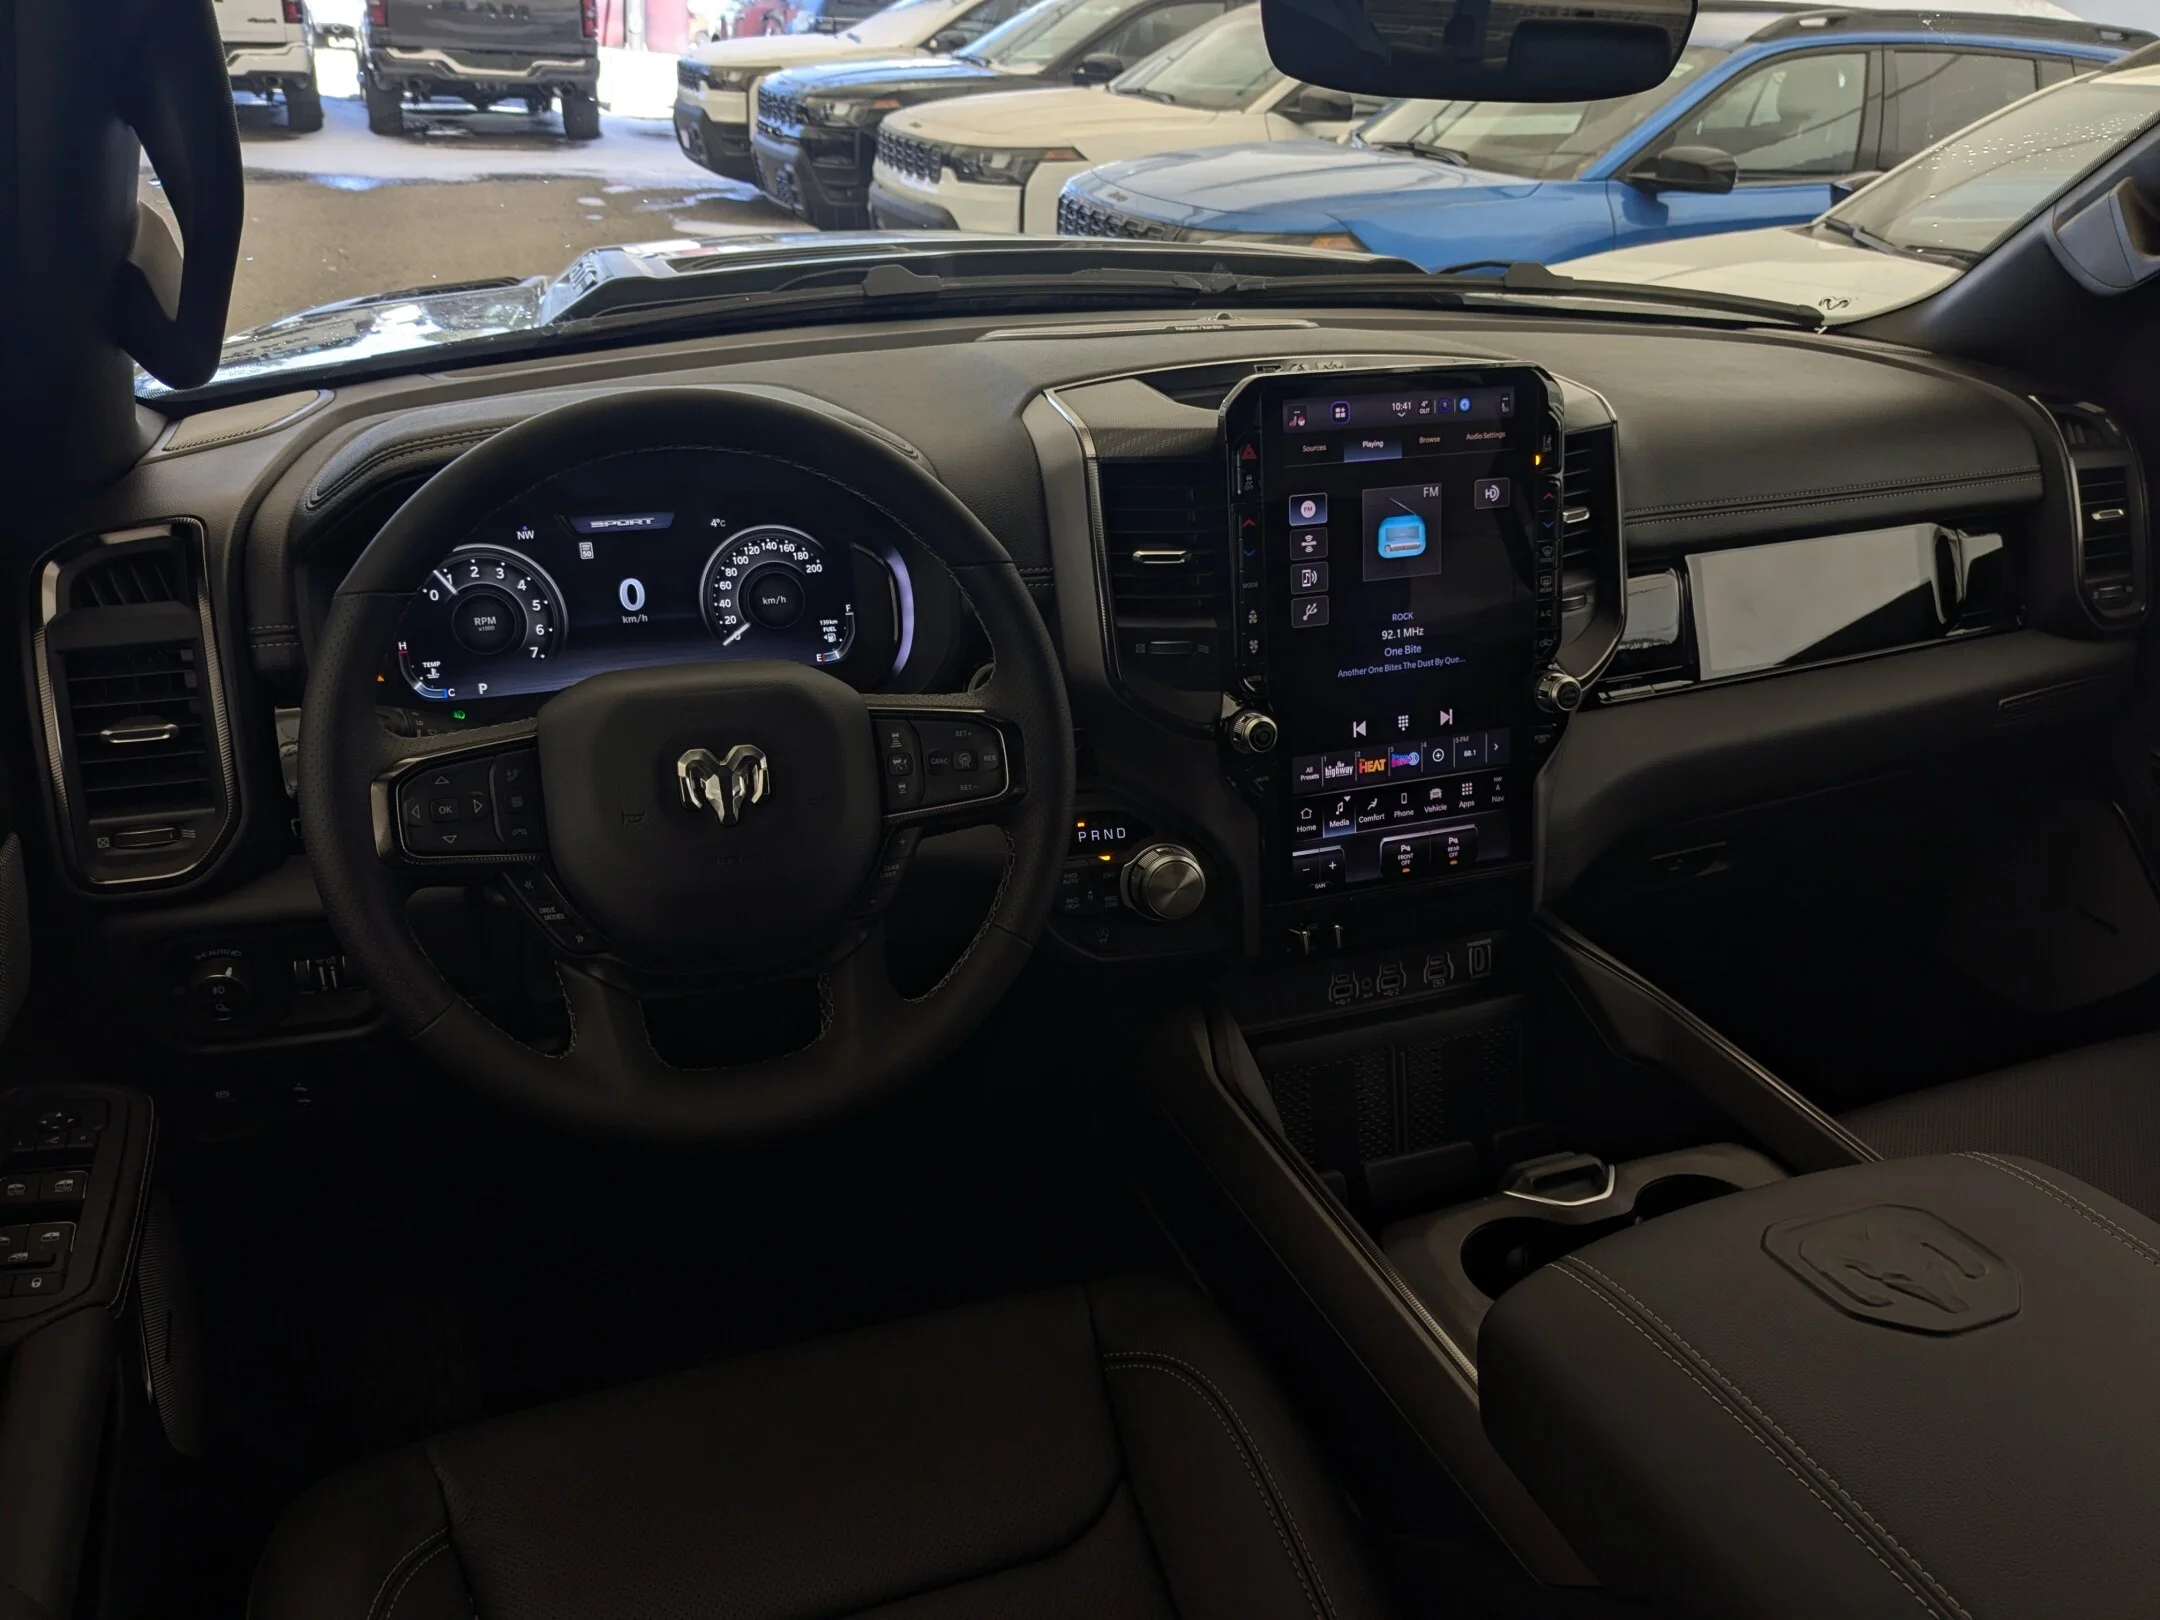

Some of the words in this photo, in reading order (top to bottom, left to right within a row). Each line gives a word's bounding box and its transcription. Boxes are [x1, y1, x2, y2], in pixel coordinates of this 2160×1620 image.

[1392, 401, 1412, 411] 10:41
[1419, 435, 1441, 444] Browse
[1466, 432, 1484, 441] Audio
[1485, 430, 1506, 441] Settings
[1302, 443, 1327, 453] Sources
[1362, 440, 1383, 450] Playing
[1423, 486, 1438, 497] FM
[591, 517, 655, 528] SPORT
[517, 530, 534, 540] NW
[744, 546, 760, 555] 120
[761, 542, 777, 551] 140
[779, 543, 795, 552] 160
[732, 556, 749, 565] 100
[793, 551, 809, 561] 180
[470, 566, 480, 578] 2
[496, 568, 505, 579] 3
[725, 568, 737, 577] 80
[806, 564, 822, 574] 200
[517, 580, 527, 591] 4
[719, 581, 732, 590] 60
[1242, 581, 1259, 589] MODE
[429, 590, 439, 601] 0
[618, 577, 645, 612] 0
[532, 600, 541, 611] 5
[719, 599, 731, 608] 40
[762, 596, 786, 605] km/h
[846, 604, 851, 612] F
[474, 616, 497, 626] RPM
[622, 614, 648, 624] km/h
[724, 615, 736, 625] 20
[1392, 612, 1414, 622] ROCK
[536, 625, 545, 636] 6
[1381, 629, 1400, 640] 92.1
[1403, 626, 1424, 638] MHz
[398, 642, 407, 650] H
[1384, 646, 1402, 657] One
[1404, 644, 1422, 654] Bite
[530, 647, 538, 658] 7
[816, 654, 823, 662] E
[1337, 668, 1366, 678] Another
[1368, 665, 1383, 675] One
[1384, 663, 1402, 673] Bites
[1403, 661, 1416, 670] The
[1417, 659, 1434, 669] Dust
[1435, 658, 1444, 668] By
[1445, 656, 1466, 666] Que...
[448, 688, 456, 697] C
[478, 683, 488, 695] P
[984, 754, 996, 762] RES
[1359, 758, 1386, 774] HEAT
[1325, 765, 1353, 778] highway
[1300, 773, 1320, 781] Presets
[1459, 800, 1475, 808] Apps
[1492, 795, 1505, 803] Nav
[438, 805, 452, 814] OK
[1394, 808, 1414, 818] Phone
[1424, 804, 1448, 813] Vehicle
[1359, 813, 1385, 823] Comfort
[1297, 824, 1317, 833] Home
[1329, 819, 1350, 828] Media
